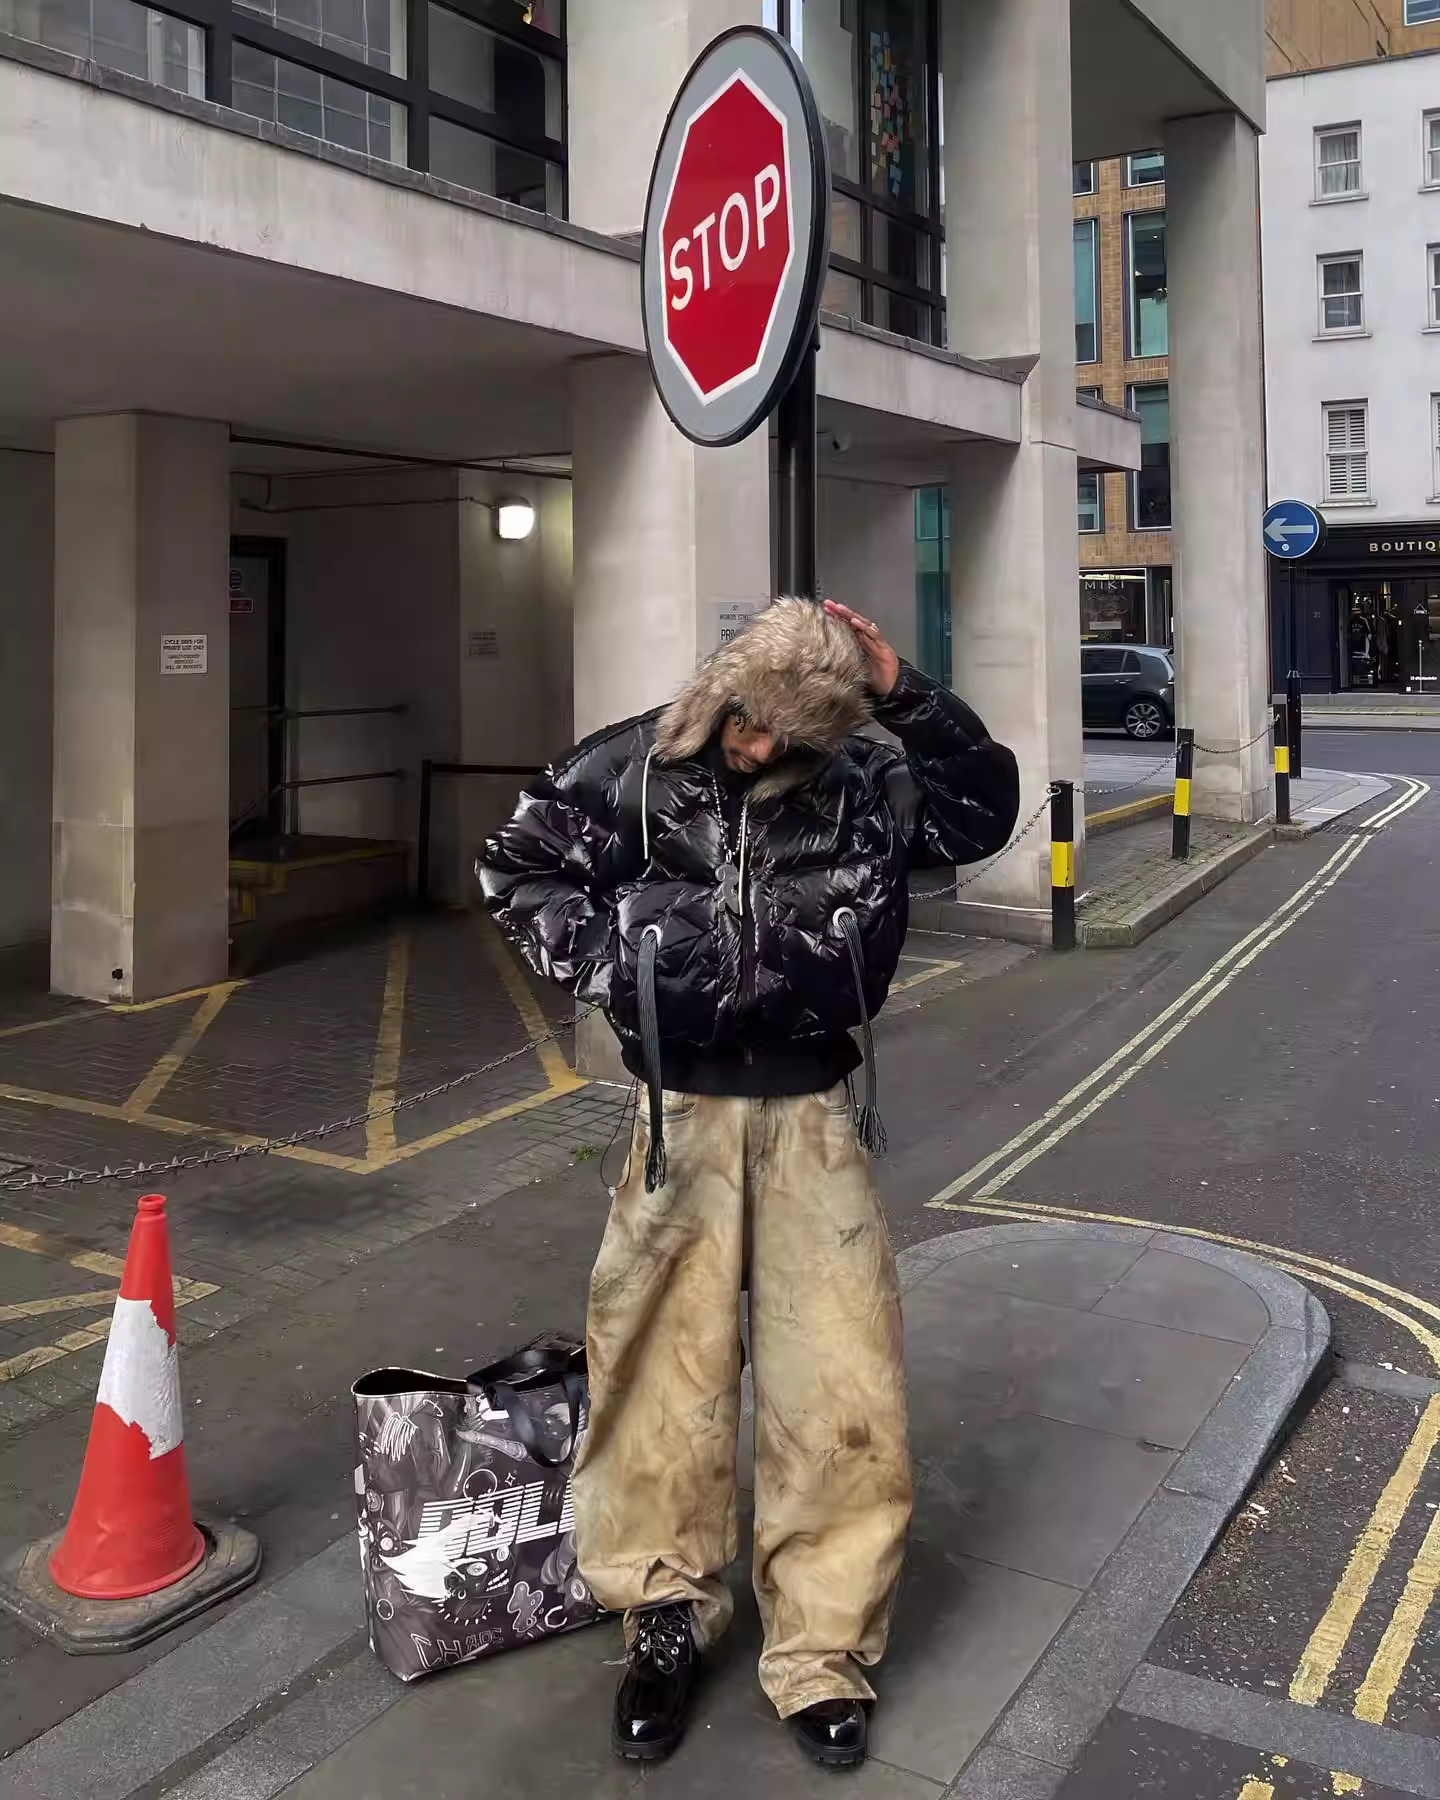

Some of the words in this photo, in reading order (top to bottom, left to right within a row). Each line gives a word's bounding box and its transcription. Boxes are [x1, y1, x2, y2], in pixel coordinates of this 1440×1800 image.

[669, 163, 780, 311] STOP
[1369, 541, 1440, 552] BOUTIQ
[1084, 580, 1124, 590] MIKI
